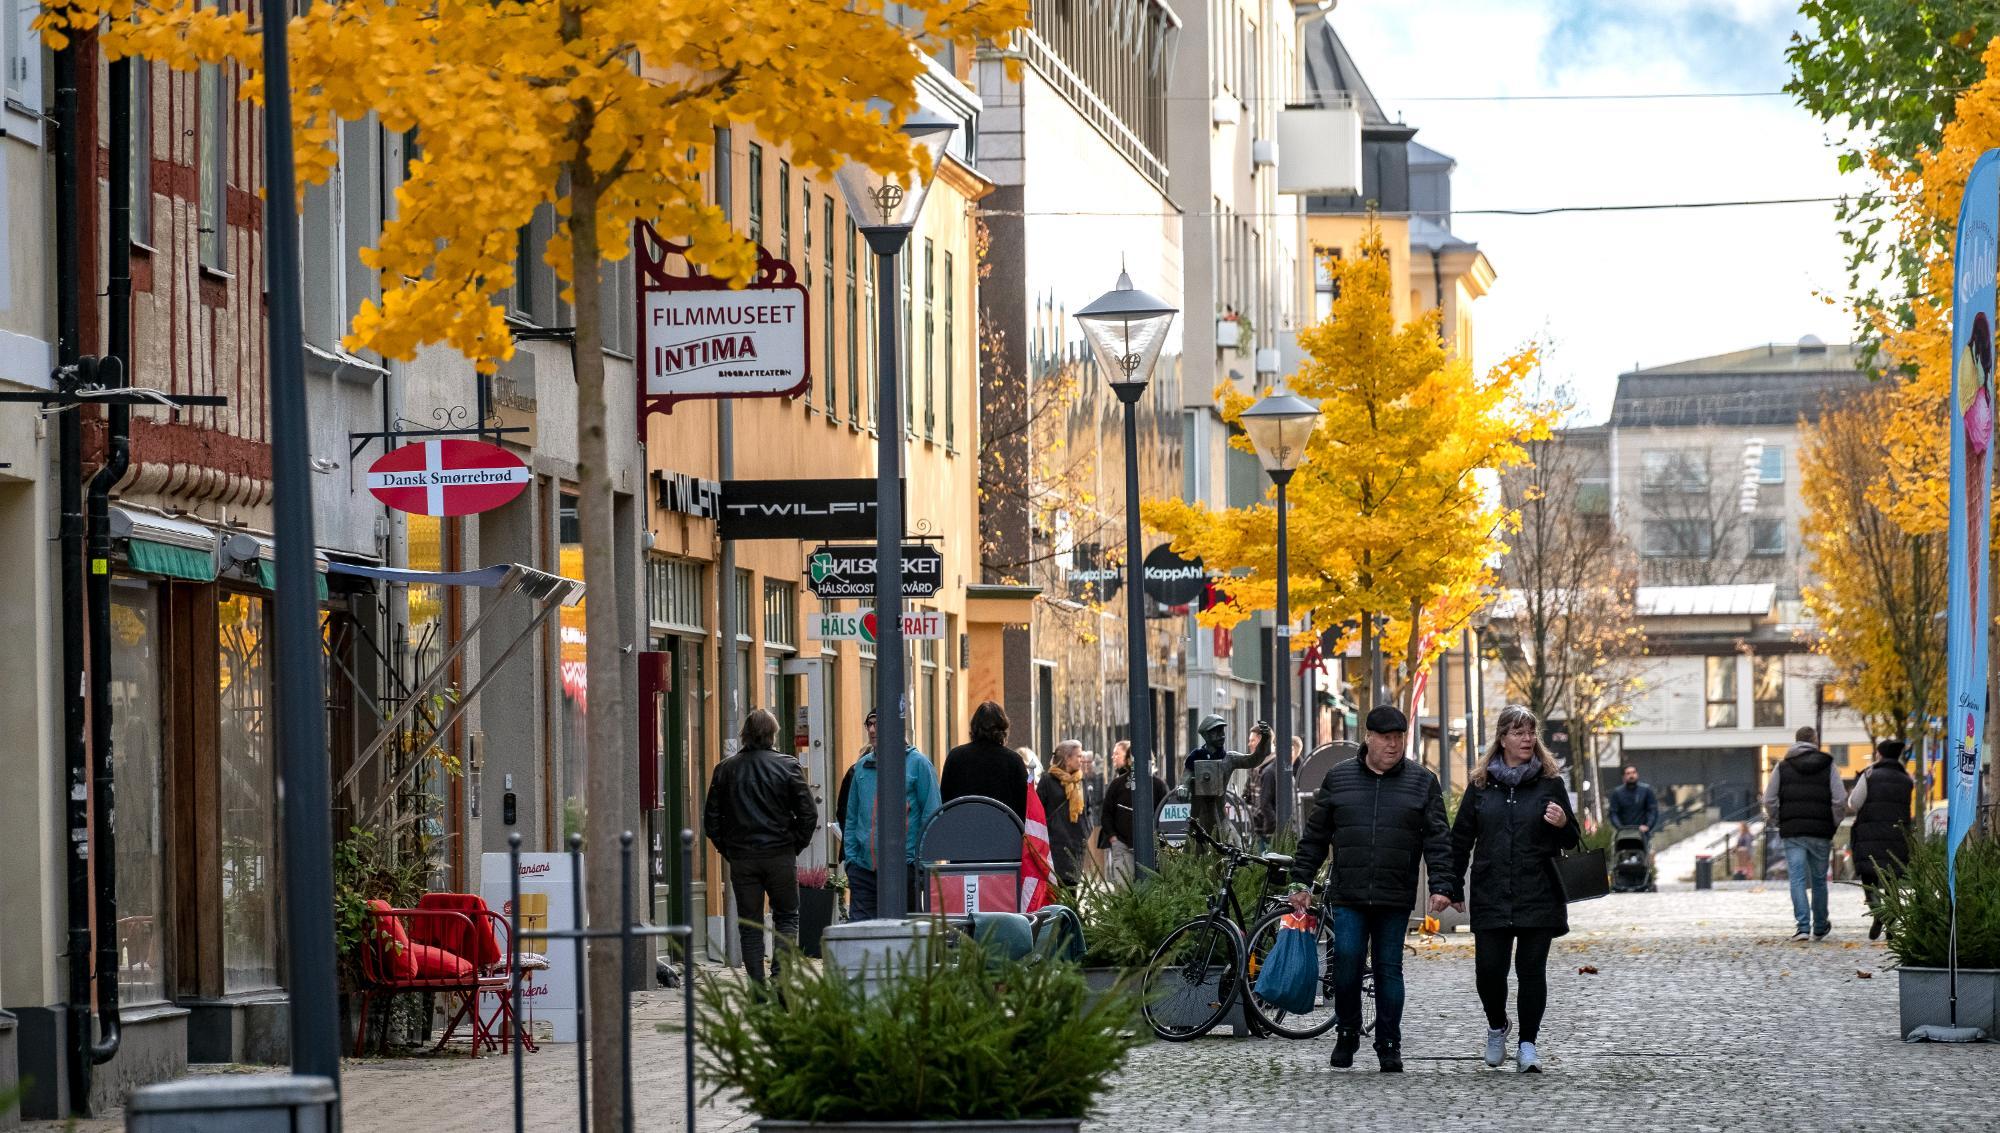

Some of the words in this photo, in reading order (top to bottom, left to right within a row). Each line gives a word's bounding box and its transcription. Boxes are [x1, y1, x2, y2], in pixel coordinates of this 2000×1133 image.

[653, 305, 796, 326] FILMMUSEET
[655, 335, 758, 377] INTIMA
[718, 368, 792, 378] BIOGRAFTEATERN
[383, 473, 427, 486] Dansk
[430, 469, 512, 484] Smørrebrød
[660, 470, 722, 521] TWILFIT
[727, 502, 878, 516] TWILFI
[1144, 565, 1203, 582] KappAhl
[818, 581, 875, 594] HÄLSOKOST
[821, 615, 857, 636] HÄLS
[903, 617, 939, 635] RAFT
[1164, 805, 1189, 820] HÄLS
[966, 883, 977, 914] Dans
[519, 984, 549, 998] nsens
